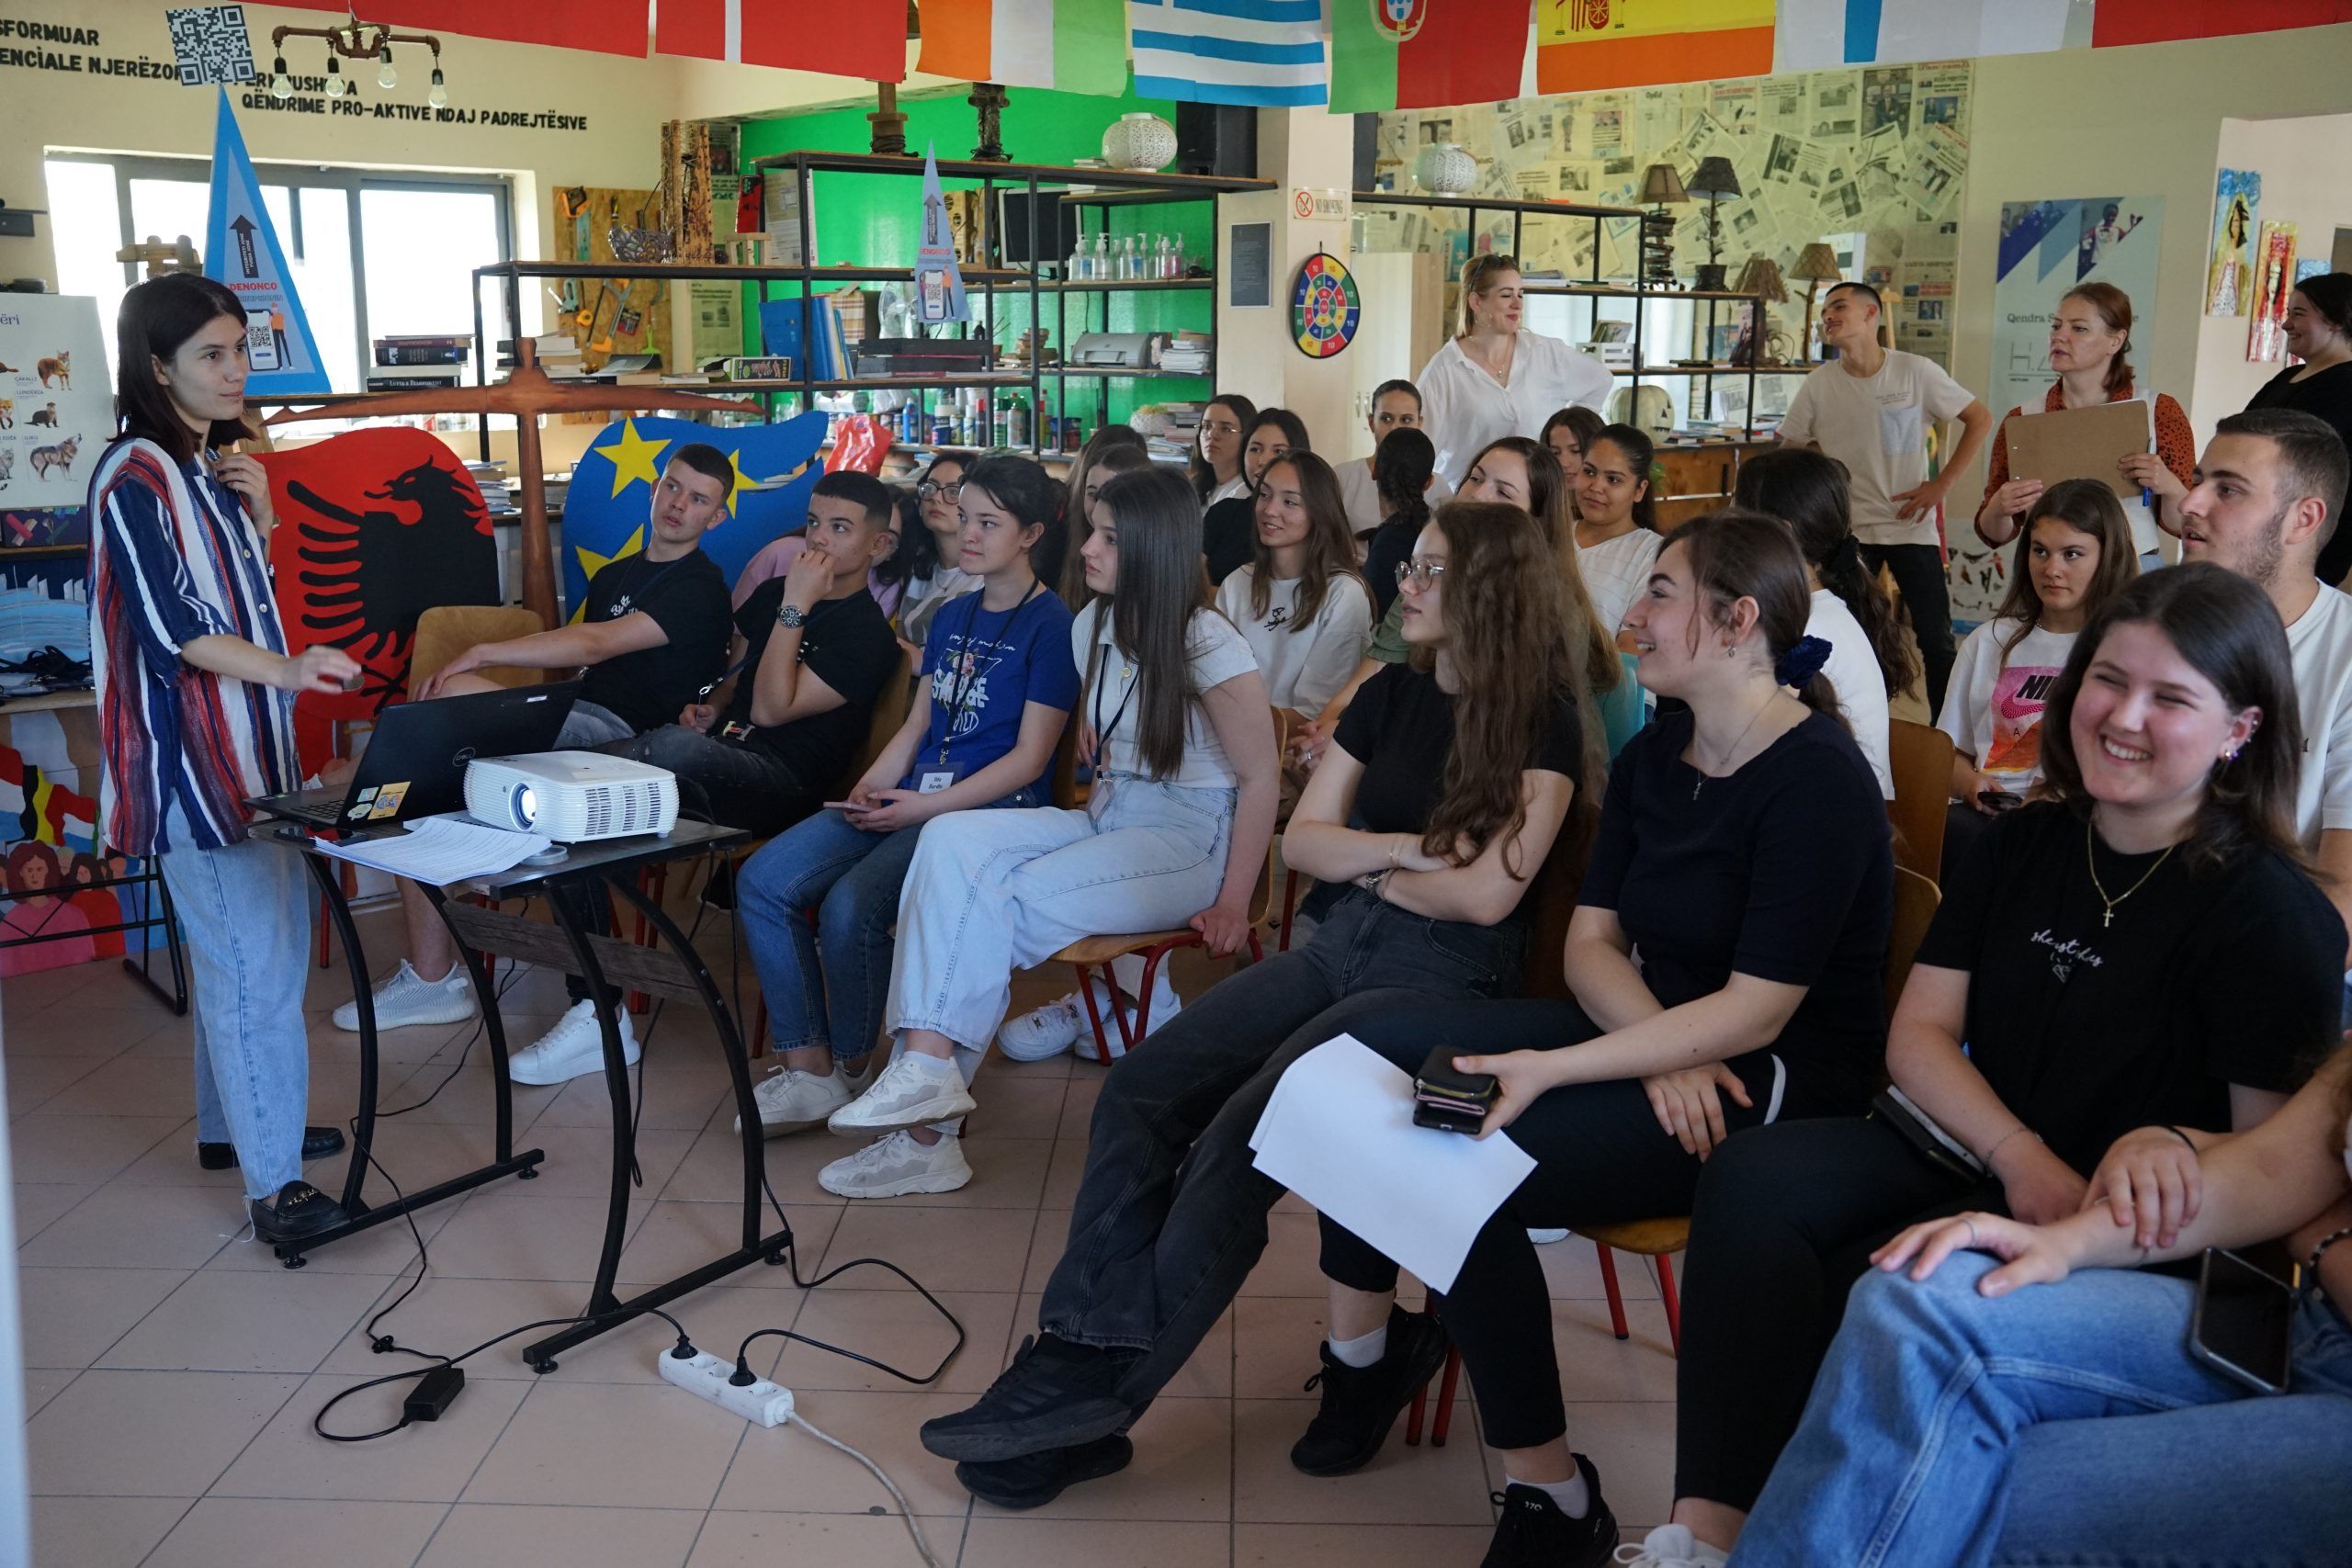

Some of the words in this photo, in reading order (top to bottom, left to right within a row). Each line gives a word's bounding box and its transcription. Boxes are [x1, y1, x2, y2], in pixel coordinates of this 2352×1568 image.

[243, 89, 325, 114] QËNDRIME
[332, 100, 431, 121] PRO-AKTIVE
[436, 107, 476, 124] NDAJ
[481, 109, 588, 130] PADREJTËSIVE
[2007, 313, 2045, 323] Qendra
